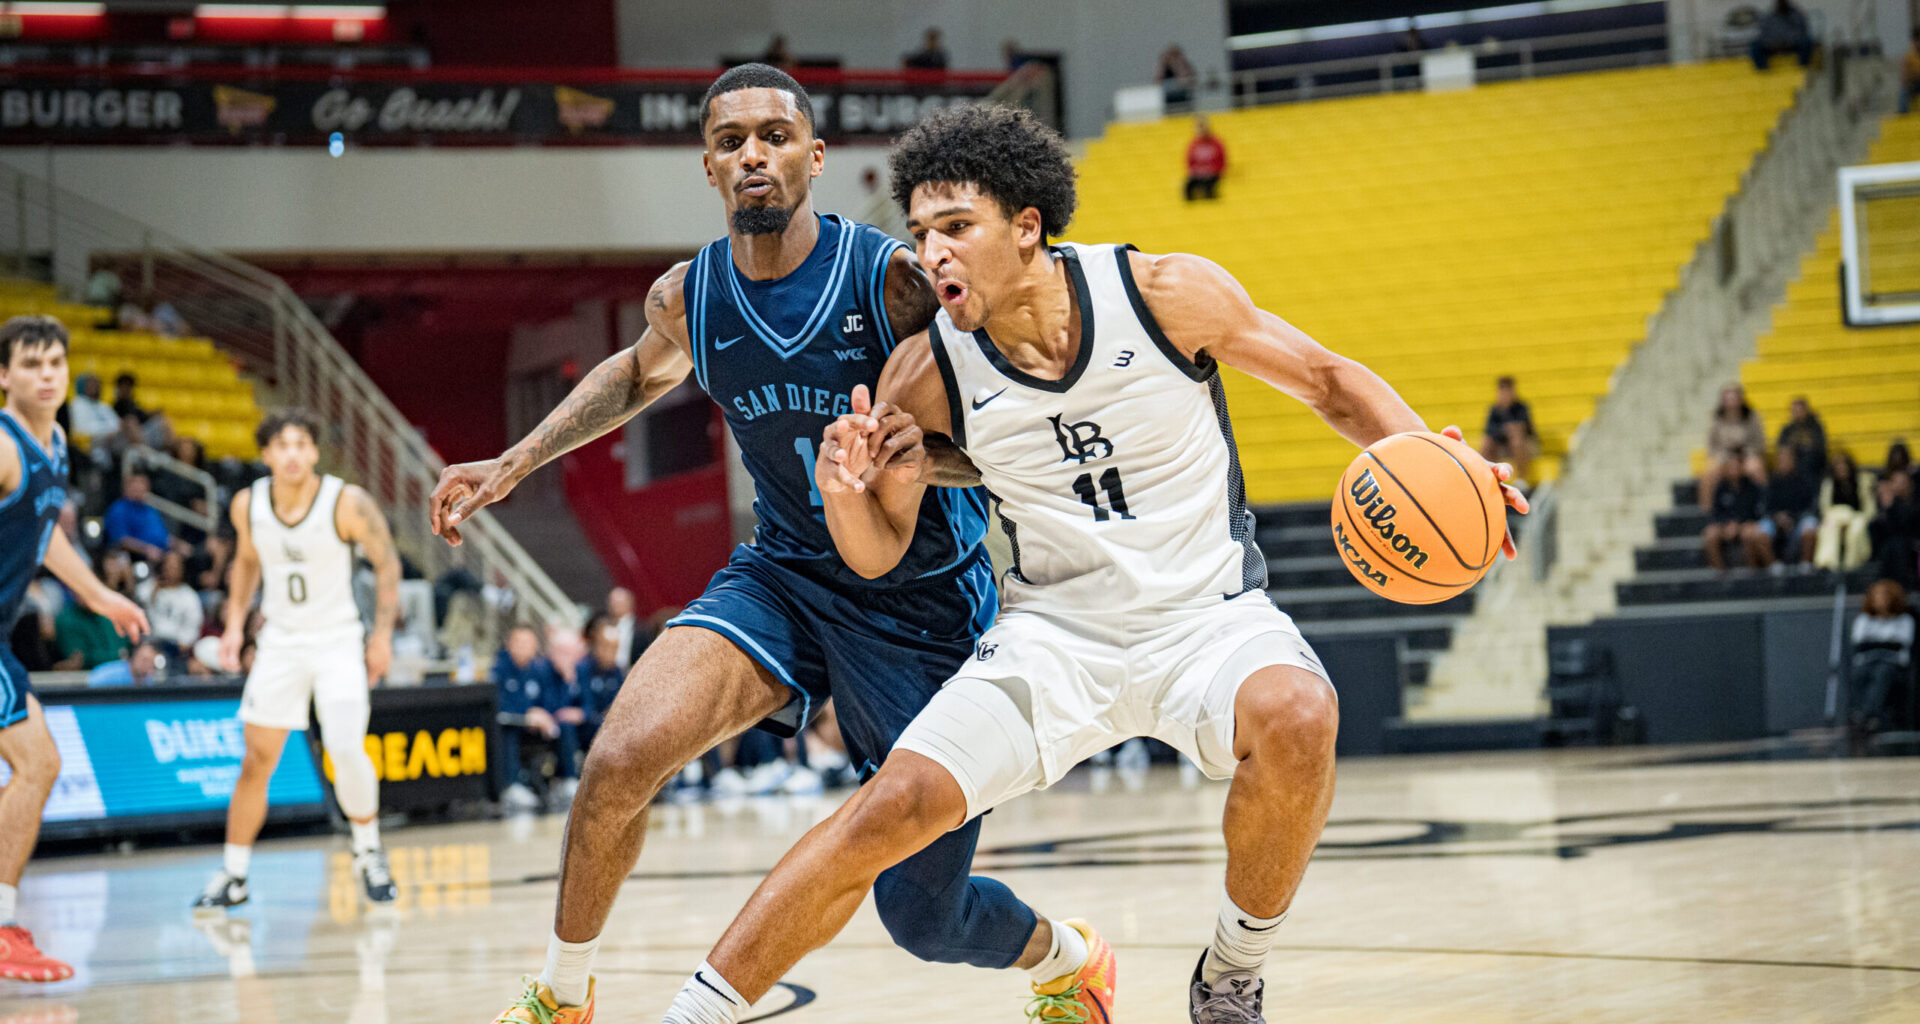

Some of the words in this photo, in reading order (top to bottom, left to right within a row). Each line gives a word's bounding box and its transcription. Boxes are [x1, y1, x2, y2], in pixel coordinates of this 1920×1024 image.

[1, 90, 183, 128] BURGER
[312, 89, 371, 130] Go
[843, 314, 864, 334] JC
[733, 384, 782, 421] SAN
[785, 383, 854, 417] DIEG
[1072, 466, 1137, 522] 11
[1351, 468, 1429, 570] Wilson
[1334, 522, 1388, 588] NCAA
[288, 572, 307, 606] 0
